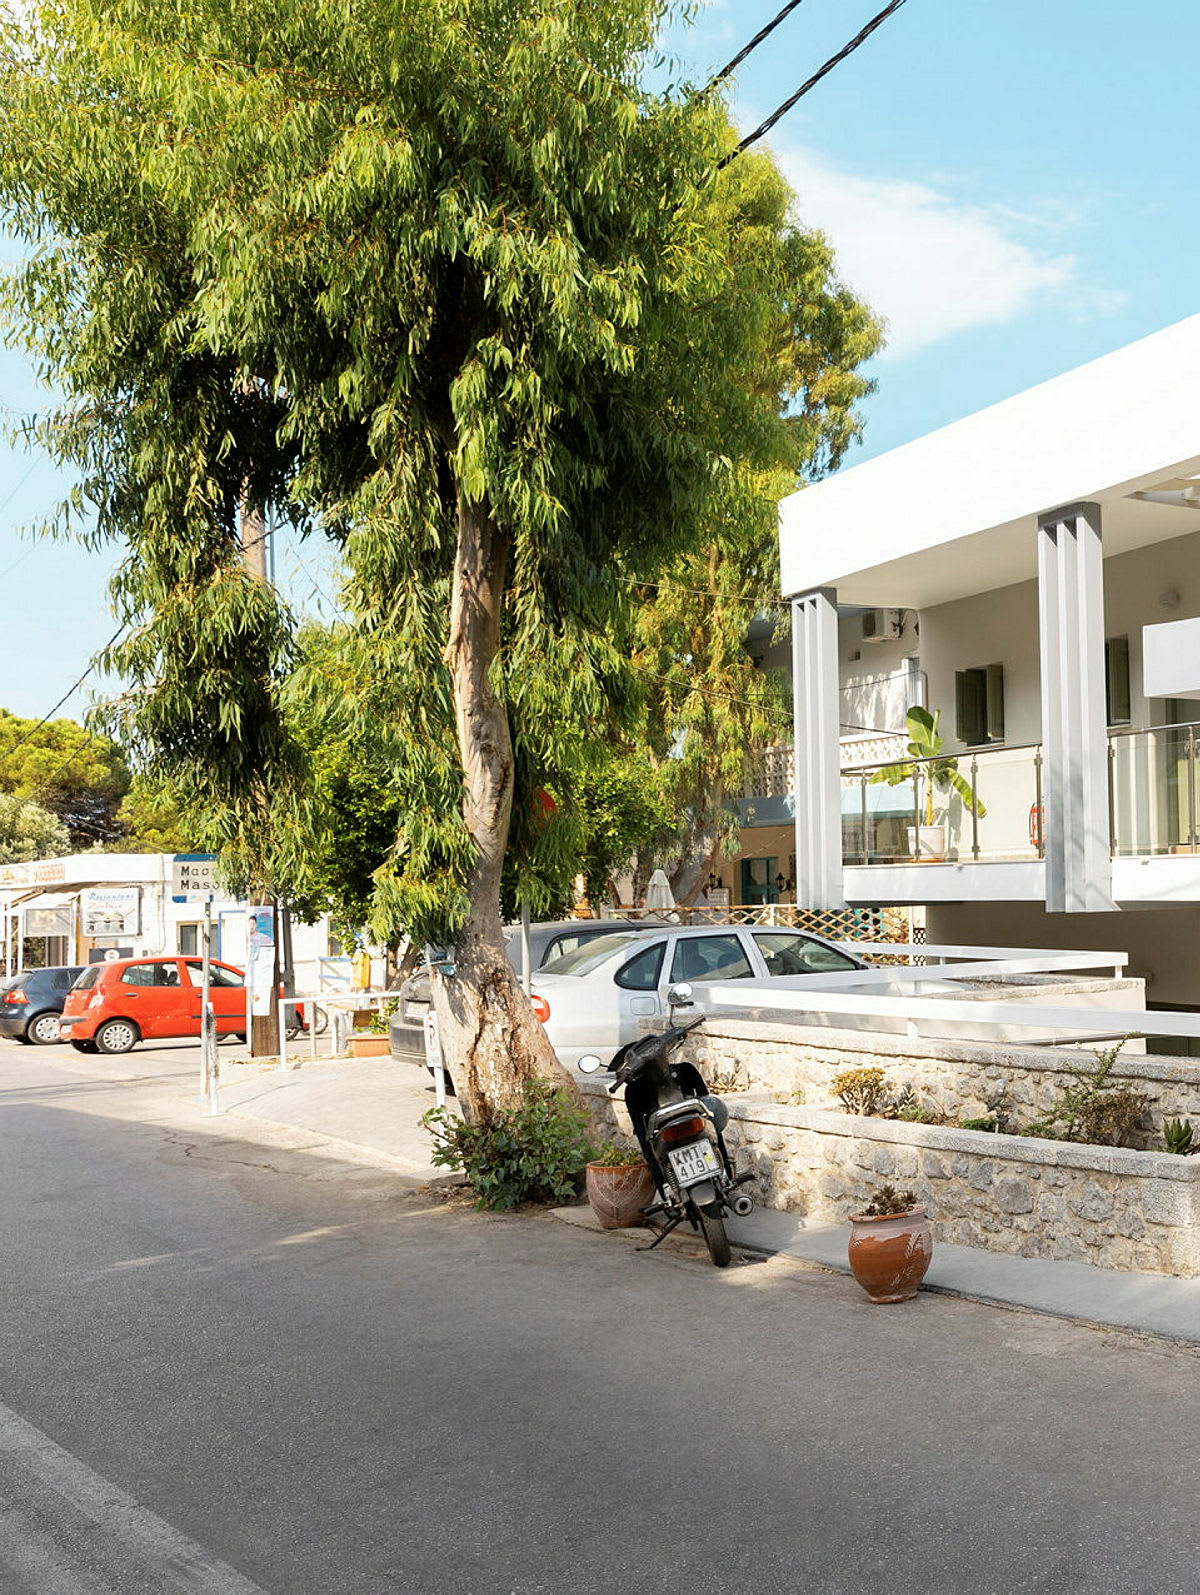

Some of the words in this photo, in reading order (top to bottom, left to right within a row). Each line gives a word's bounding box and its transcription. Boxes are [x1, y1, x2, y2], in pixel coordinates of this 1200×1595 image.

[180, 879, 220, 890] Maso
[672, 1145, 700, 1166] KMT
[680, 1159, 706, 1178] 419
